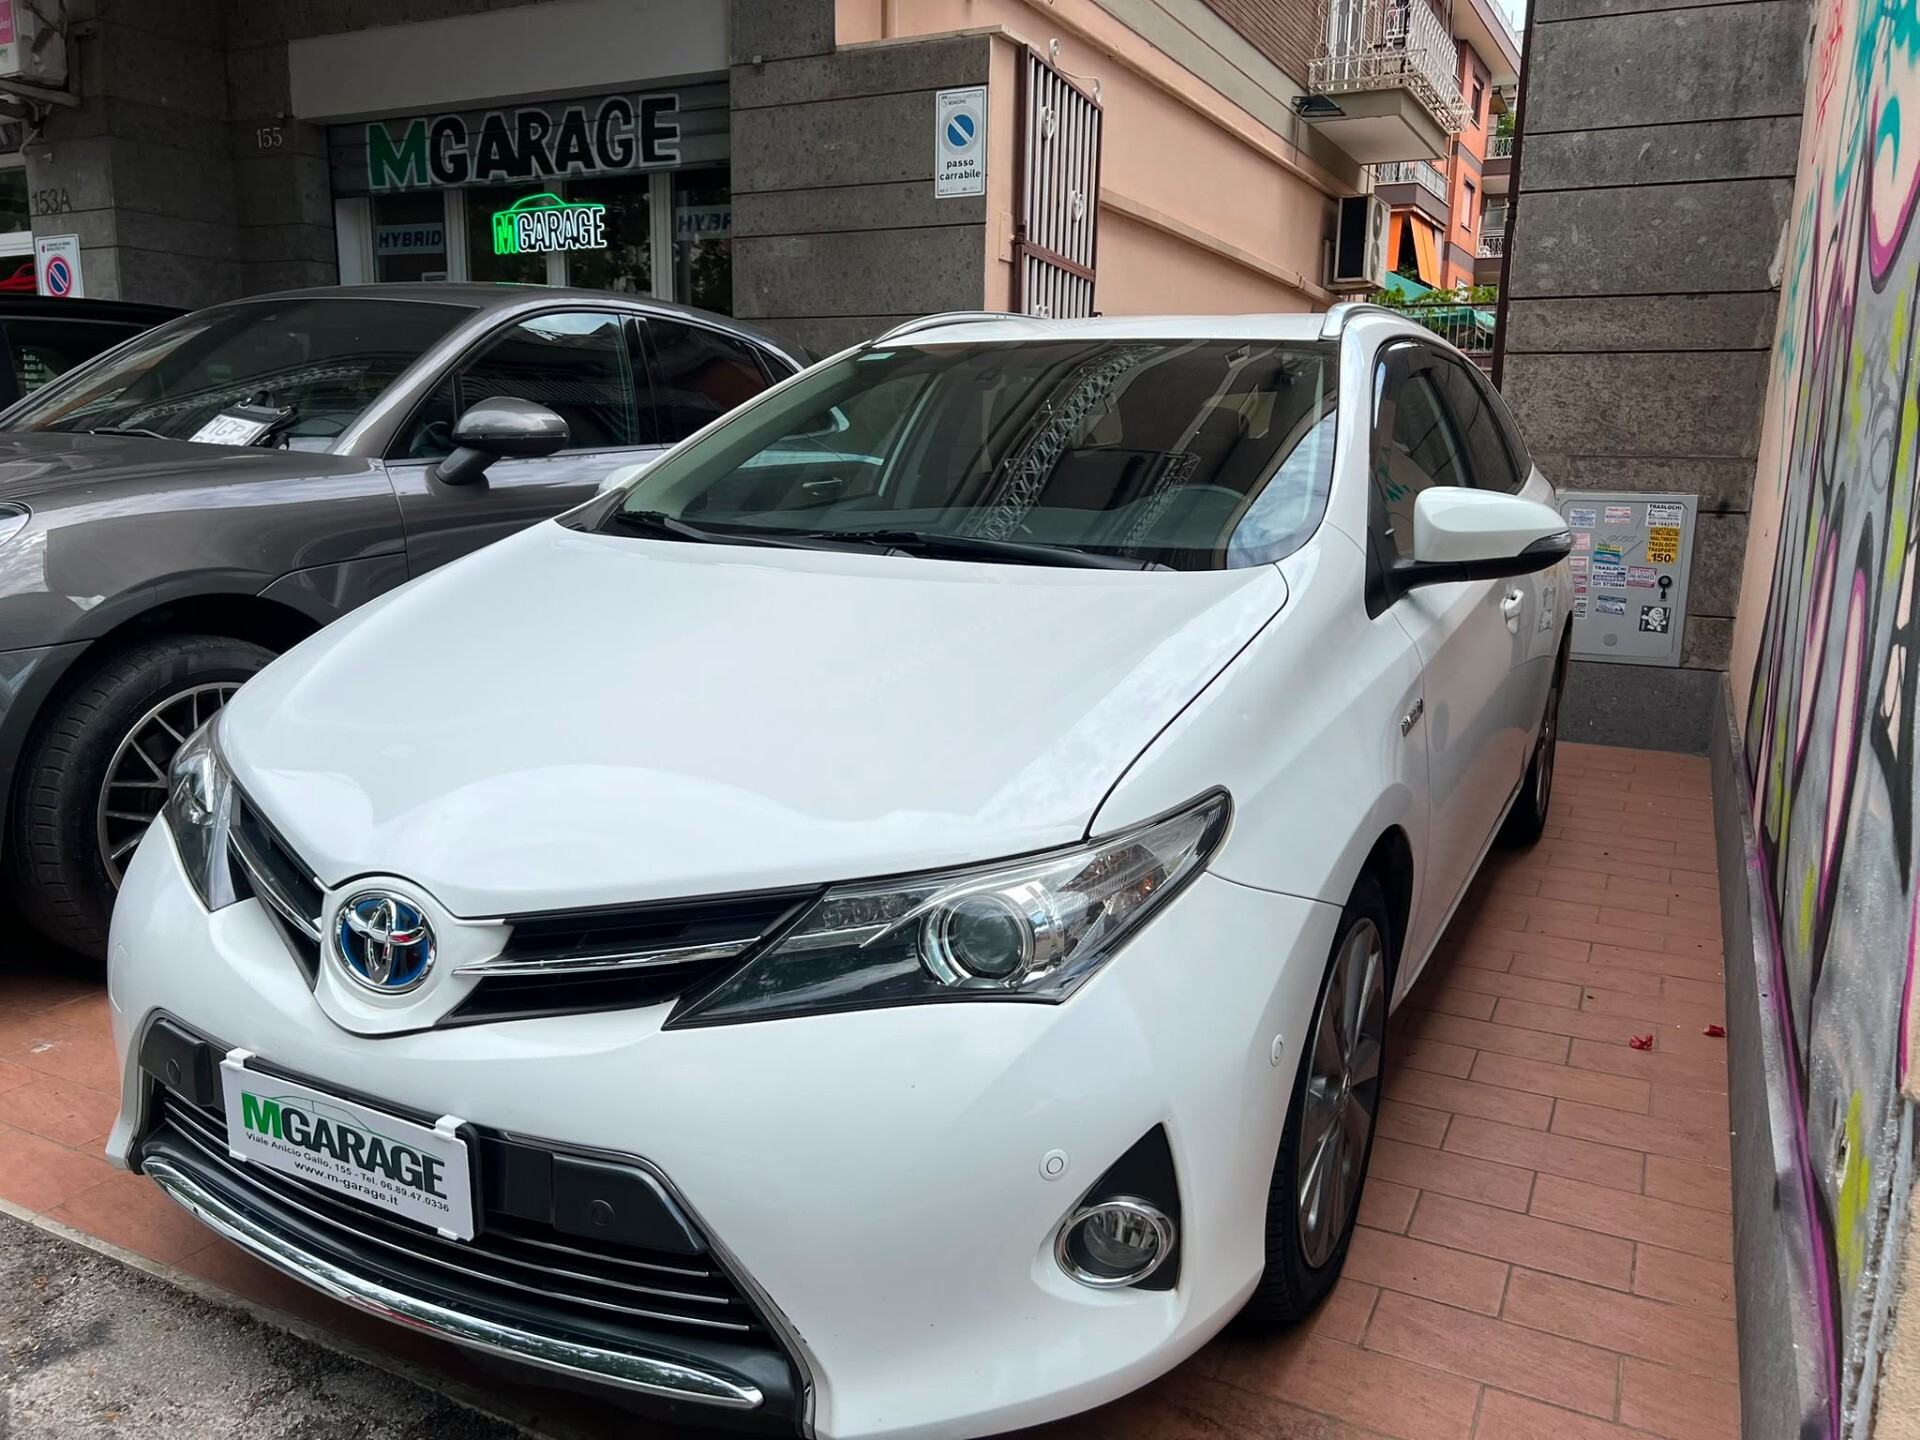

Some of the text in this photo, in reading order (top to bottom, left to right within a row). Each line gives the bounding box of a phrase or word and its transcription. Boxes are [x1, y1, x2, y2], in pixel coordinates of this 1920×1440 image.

[256, 127, 283, 149] 155
[366, 94, 681, 190] MGARAGE
[939, 168, 981, 181] carrabile
[946, 159, 974, 170] passo
[31, 187, 73, 215] 153A
[377, 228, 443, 250] HYBRID
[492, 206, 608, 255] MGARAGE
[240, 1092, 448, 1200] MGARAGE
[246, 1131, 269, 1147] Viale
[271, 1141, 301, 1158] Anicio
[304, 1152, 332, 1170] Gallo,
[335, 1163, 352, 1176] 155
[360, 1172, 379, 1186] Tel.
[380, 1180, 450, 1213] 06.89.47.0336
[294, 1160, 399, 1206] www.m-garage.it
